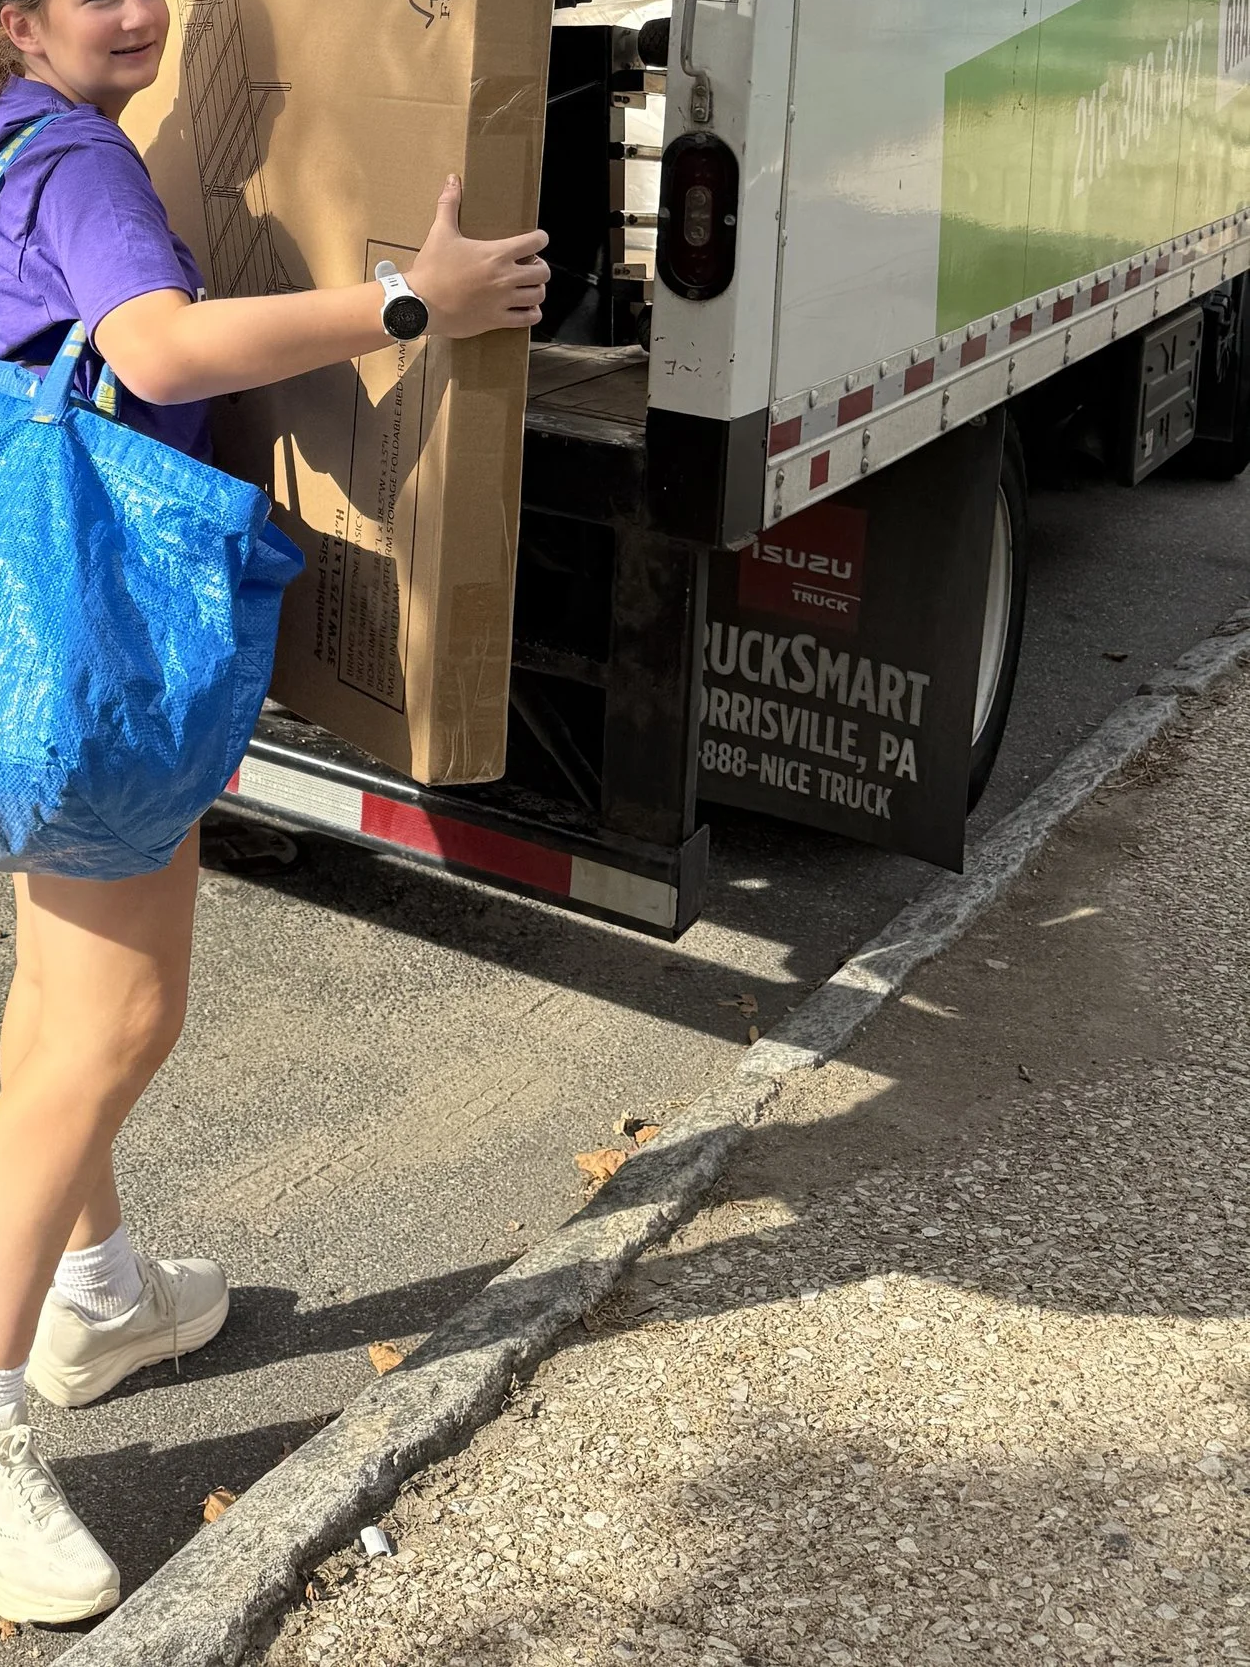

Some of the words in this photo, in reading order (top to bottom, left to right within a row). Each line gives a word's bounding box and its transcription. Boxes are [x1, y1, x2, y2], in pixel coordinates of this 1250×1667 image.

[396, 342, 408, 379] FRAM
[395, 381, 404, 407] BED
[390, 408, 403, 474] FOLDABLE
[386, 476, 398, 534] STORAGE
[334, 553, 342, 563] x
[381, 535, 394, 604] PLATFORM
[751, 540, 853, 581] ISUZU
[313, 567, 327, 660] Assembled
[390, 581, 400, 642] VIETNAM
[791, 588, 850, 614] TRUCK
[385, 659, 396, 699] MADE
[389, 642, 398, 658] IN
[703, 620, 931, 727] UCKSMART
[700, 684, 867, 774] RRISVILLE,
[877, 728, 919, 784] PA
[698, 738, 811, 797] 888-NICE
[818, 766, 894, 821] TRUCK
